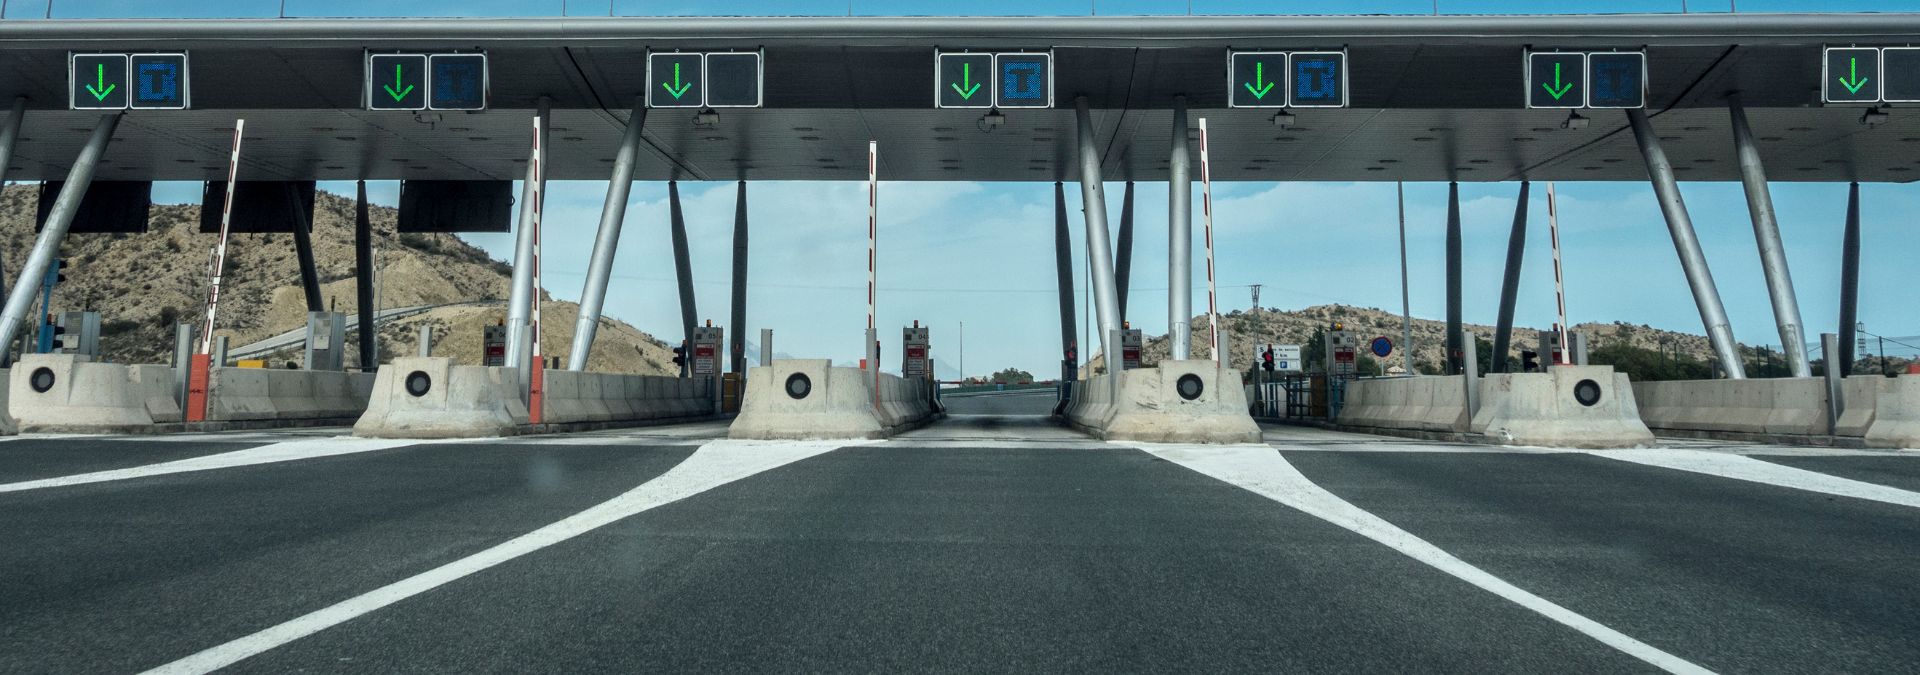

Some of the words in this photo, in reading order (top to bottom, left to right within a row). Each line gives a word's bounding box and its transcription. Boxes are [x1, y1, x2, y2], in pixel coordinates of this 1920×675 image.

[144, 69, 170, 94] T
[1009, 69, 1034, 92] T
[1303, 68, 1329, 92] T
